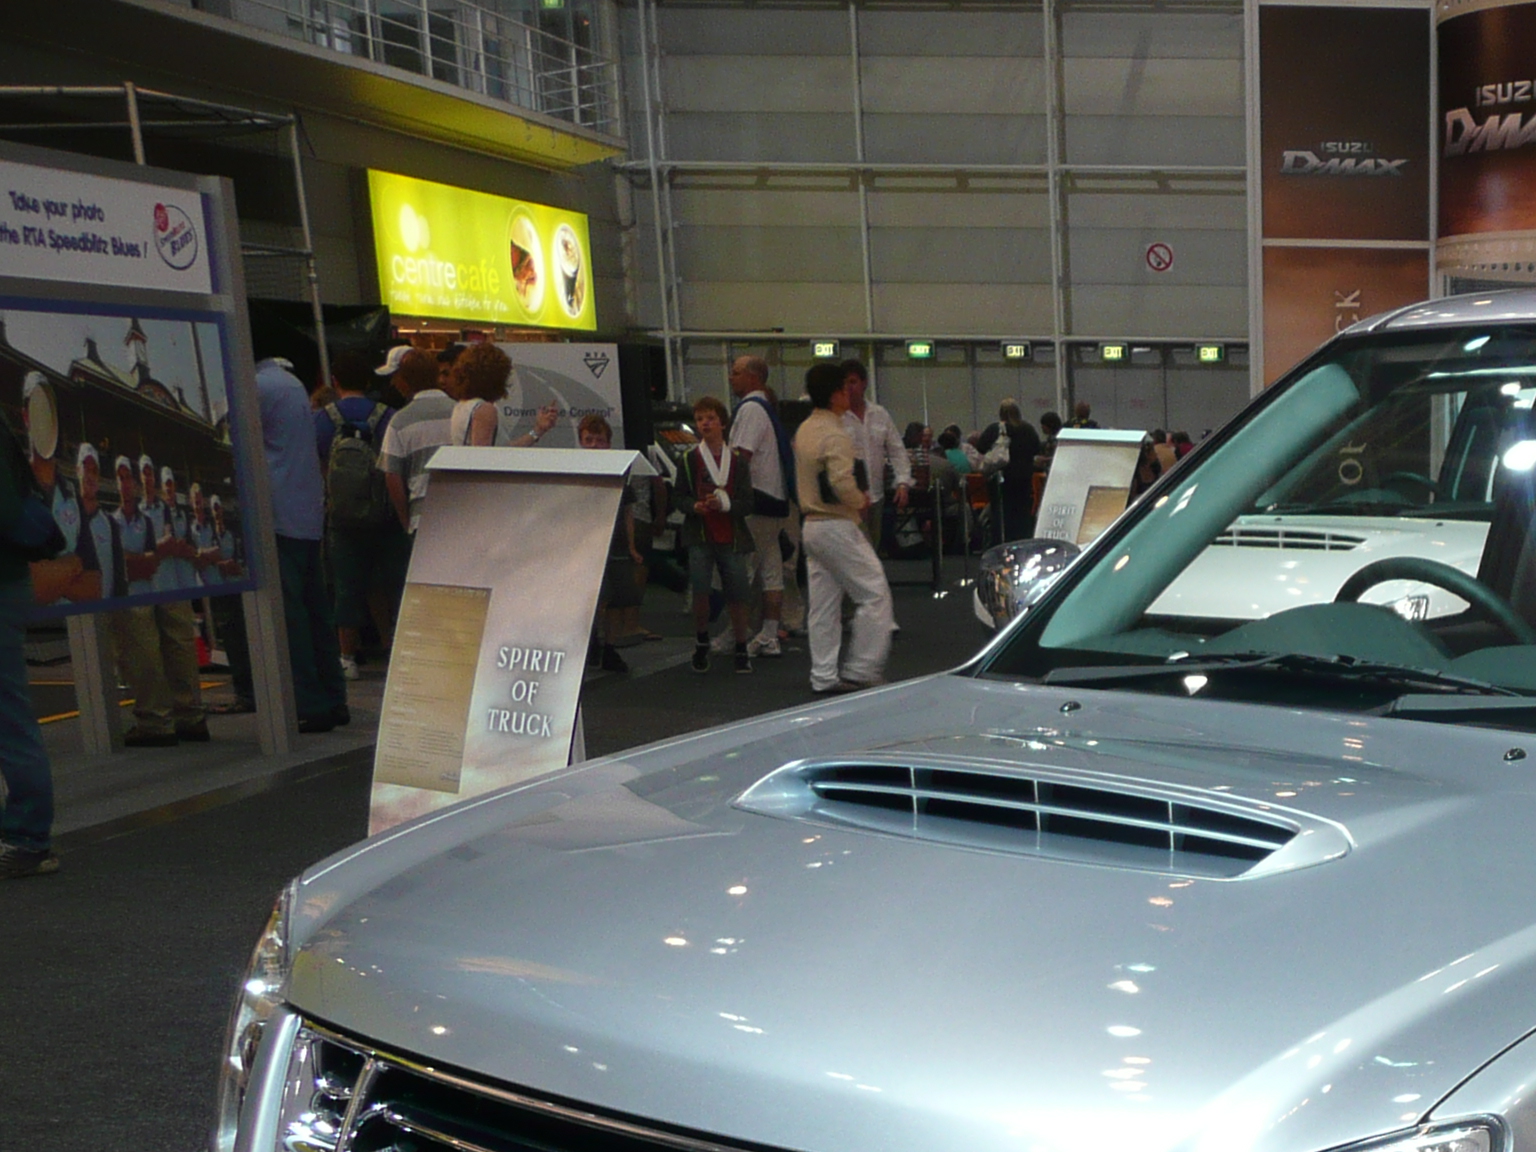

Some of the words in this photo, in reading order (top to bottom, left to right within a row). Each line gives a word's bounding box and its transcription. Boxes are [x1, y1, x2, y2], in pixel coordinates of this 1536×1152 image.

[1321, 141, 1374, 153] ISUZU
[9, 190, 40, 213] Take
[43, 199, 68, 221] your
[71, 198, 105, 223] photo
[23, 225, 47, 248] RTA
[814, 343, 834, 356] EXIT
[1006, 345, 1025, 357] EXIT
[1103, 346, 1122, 357] EXIT
[1200, 347, 1218, 360] EXIT
[503, 406, 536, 418] Down
[497, 646, 565, 674] SPIRIT
[511, 680, 539, 705] OF
[487, 708, 553, 737] TRUCK
